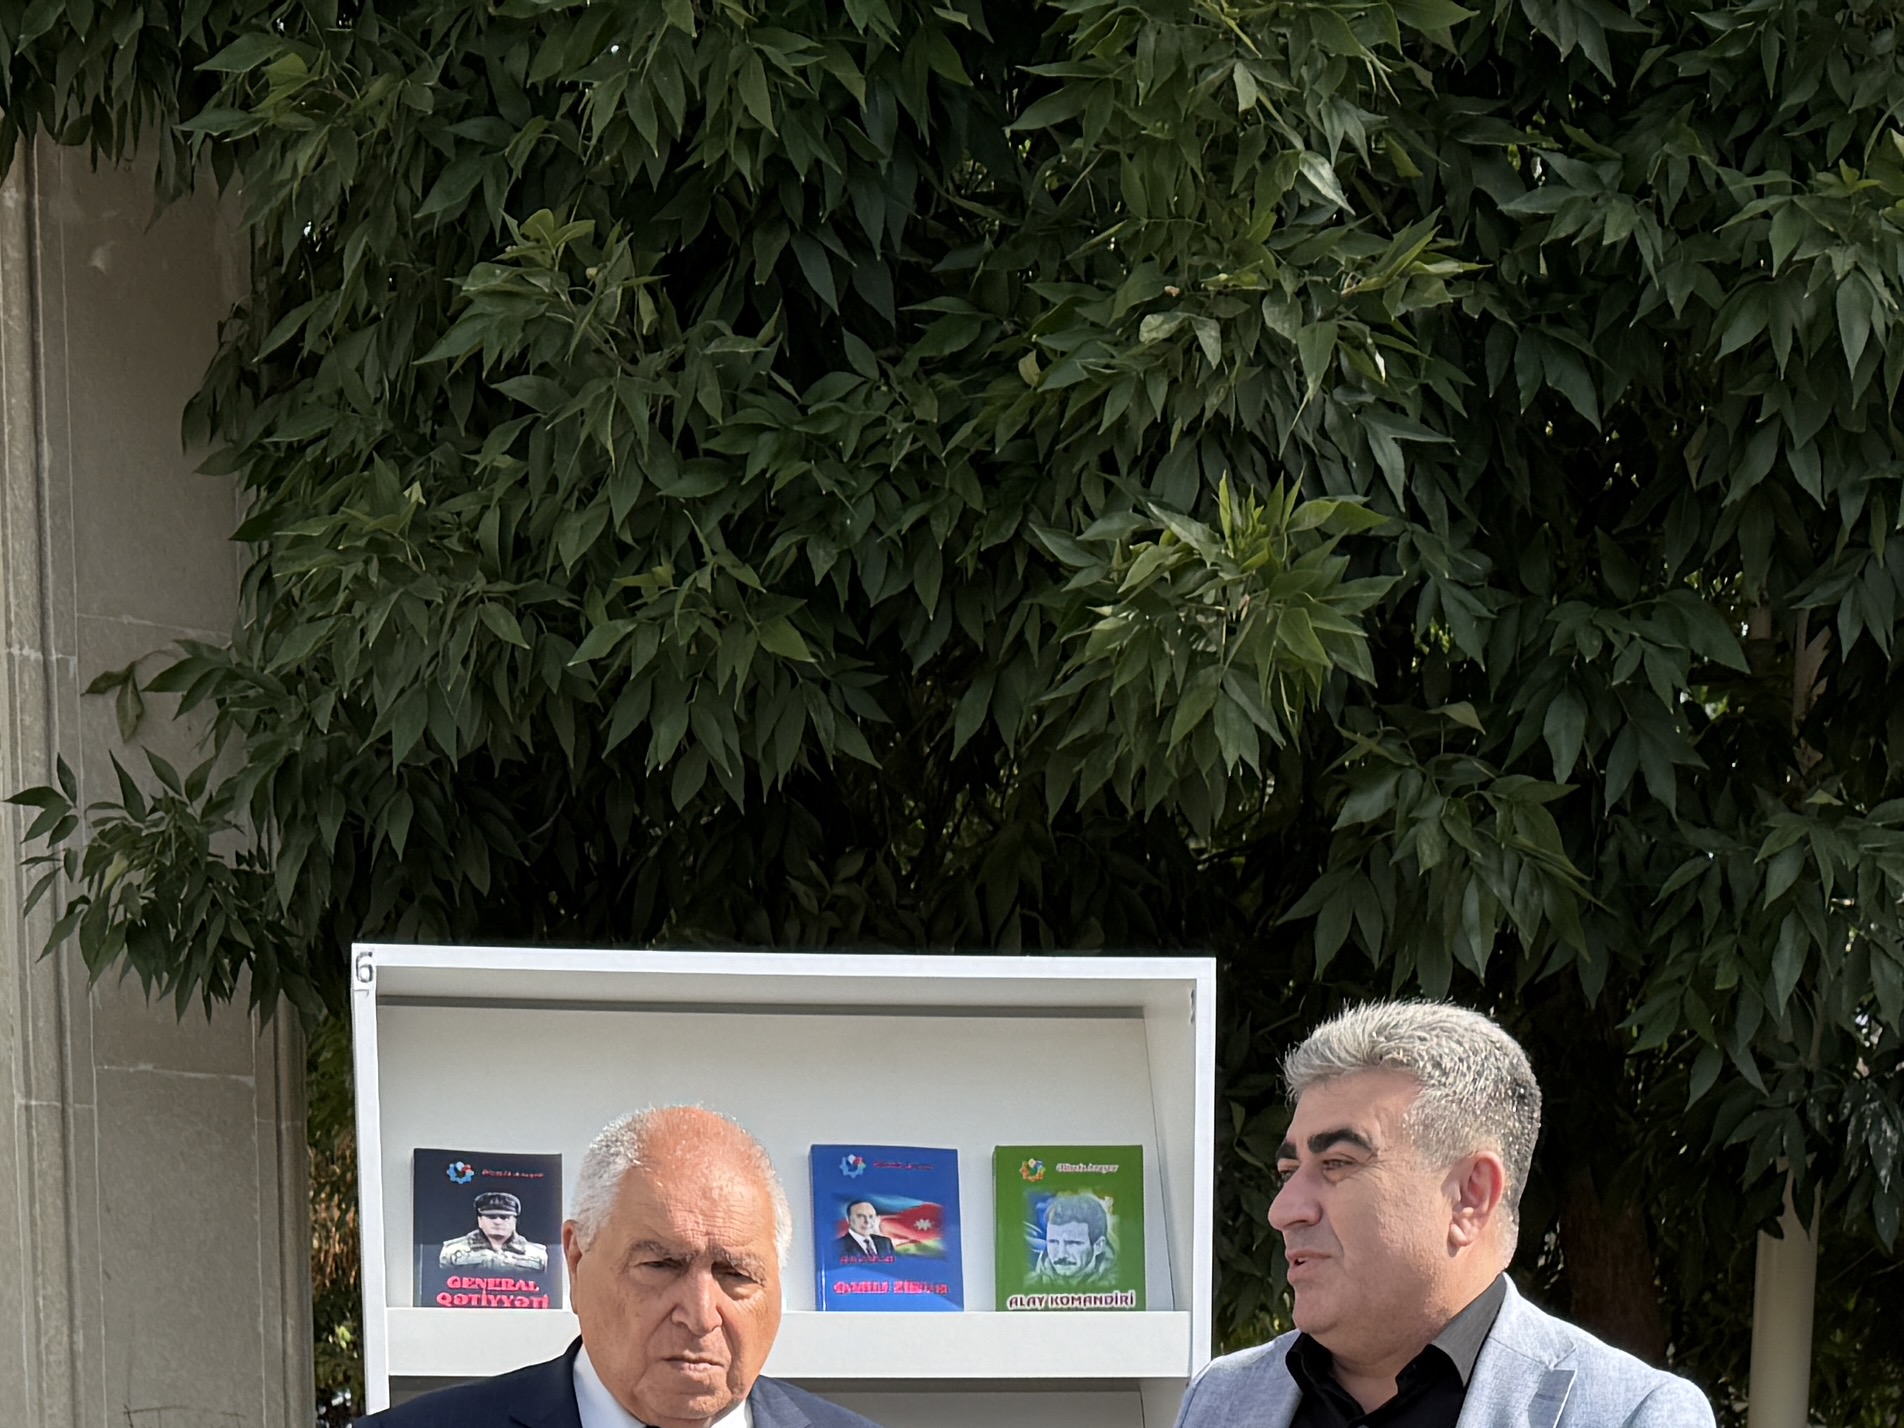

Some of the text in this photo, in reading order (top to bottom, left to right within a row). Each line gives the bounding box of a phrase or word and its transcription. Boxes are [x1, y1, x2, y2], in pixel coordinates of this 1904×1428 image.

[447, 1276, 540, 1291] GENERAL
[1007, 1290, 1136, 1310] ALAY KOMANDİRİ
